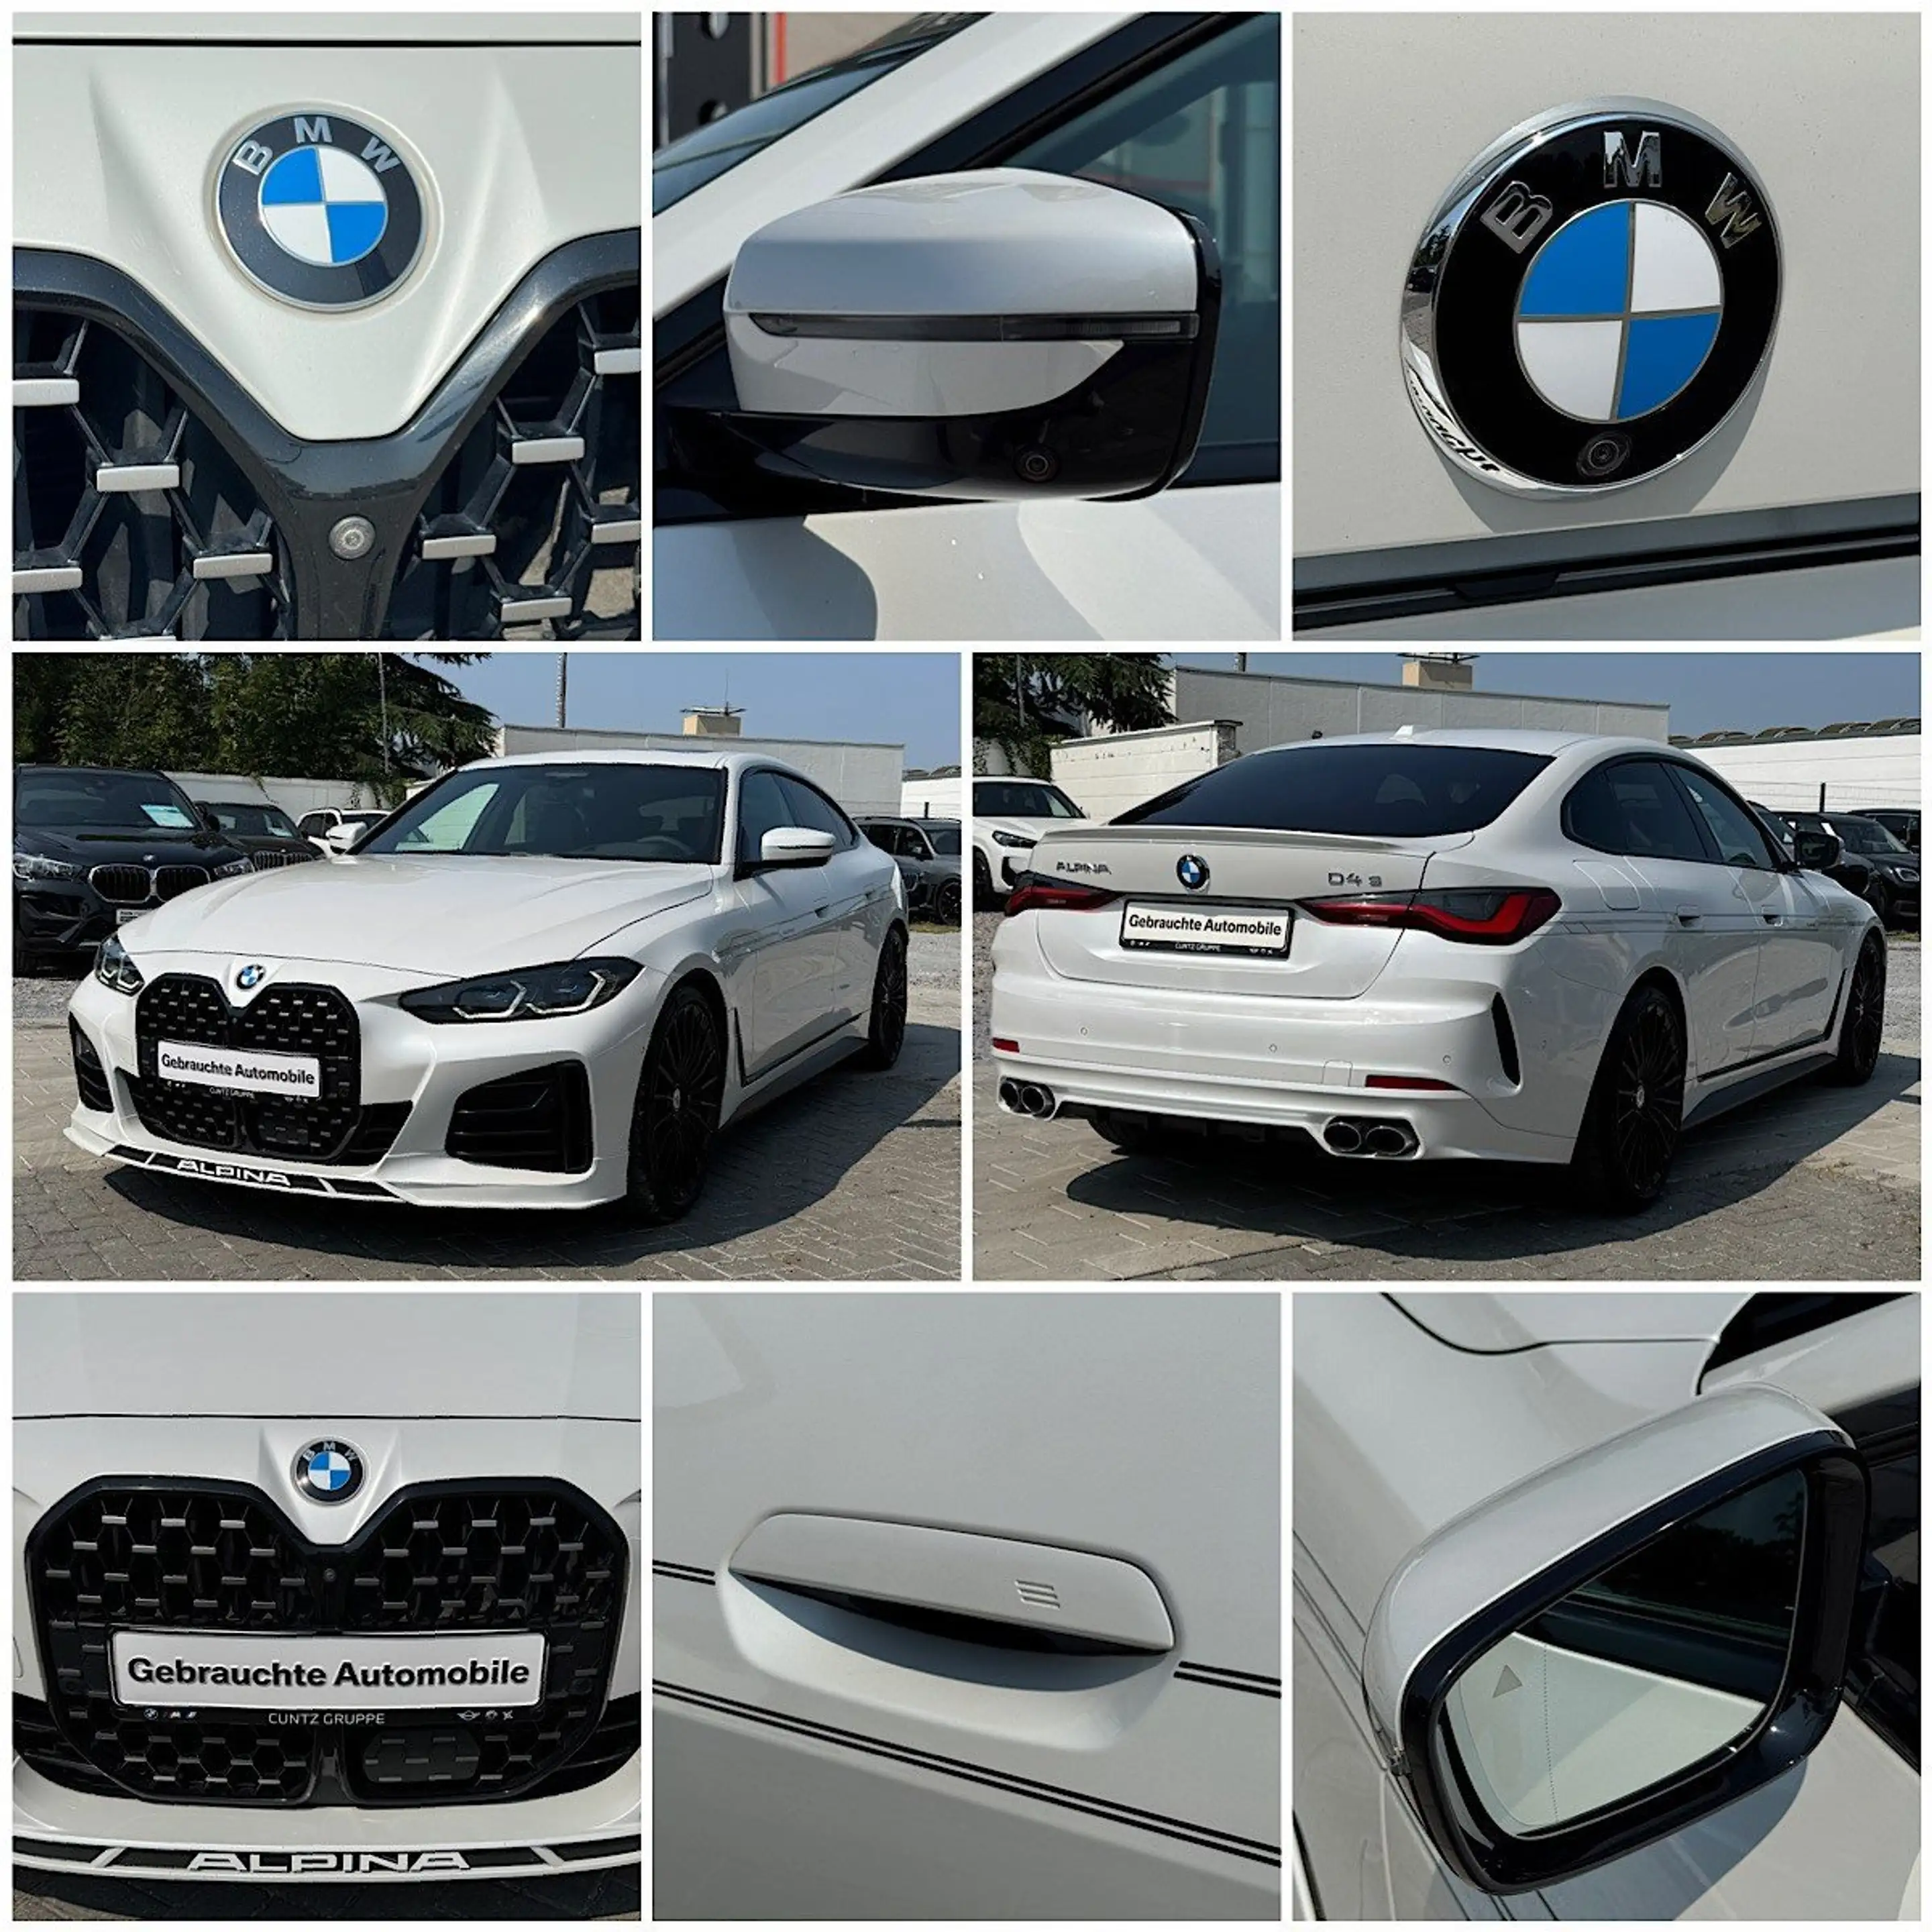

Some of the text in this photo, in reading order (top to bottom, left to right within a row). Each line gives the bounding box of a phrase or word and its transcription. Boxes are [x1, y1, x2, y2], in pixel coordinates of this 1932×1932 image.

[231, 116, 402, 176] BMW
[1479, 131, 1762, 254] BMW
[1129, 914, 1282, 936] Gebrauchte Automobile
[161, 1053, 315, 1085] Gebrauchte Automobile
[177, 1159, 291, 1187] ALPINA
[303, 1442, 358, 1462] BMW
[127, 1657, 530, 1686] Gebrauchte Automobile
[268, 1713, 386, 1725] CUNTZ GRUPPE
[186, 1851, 470, 1873] ALPINA
